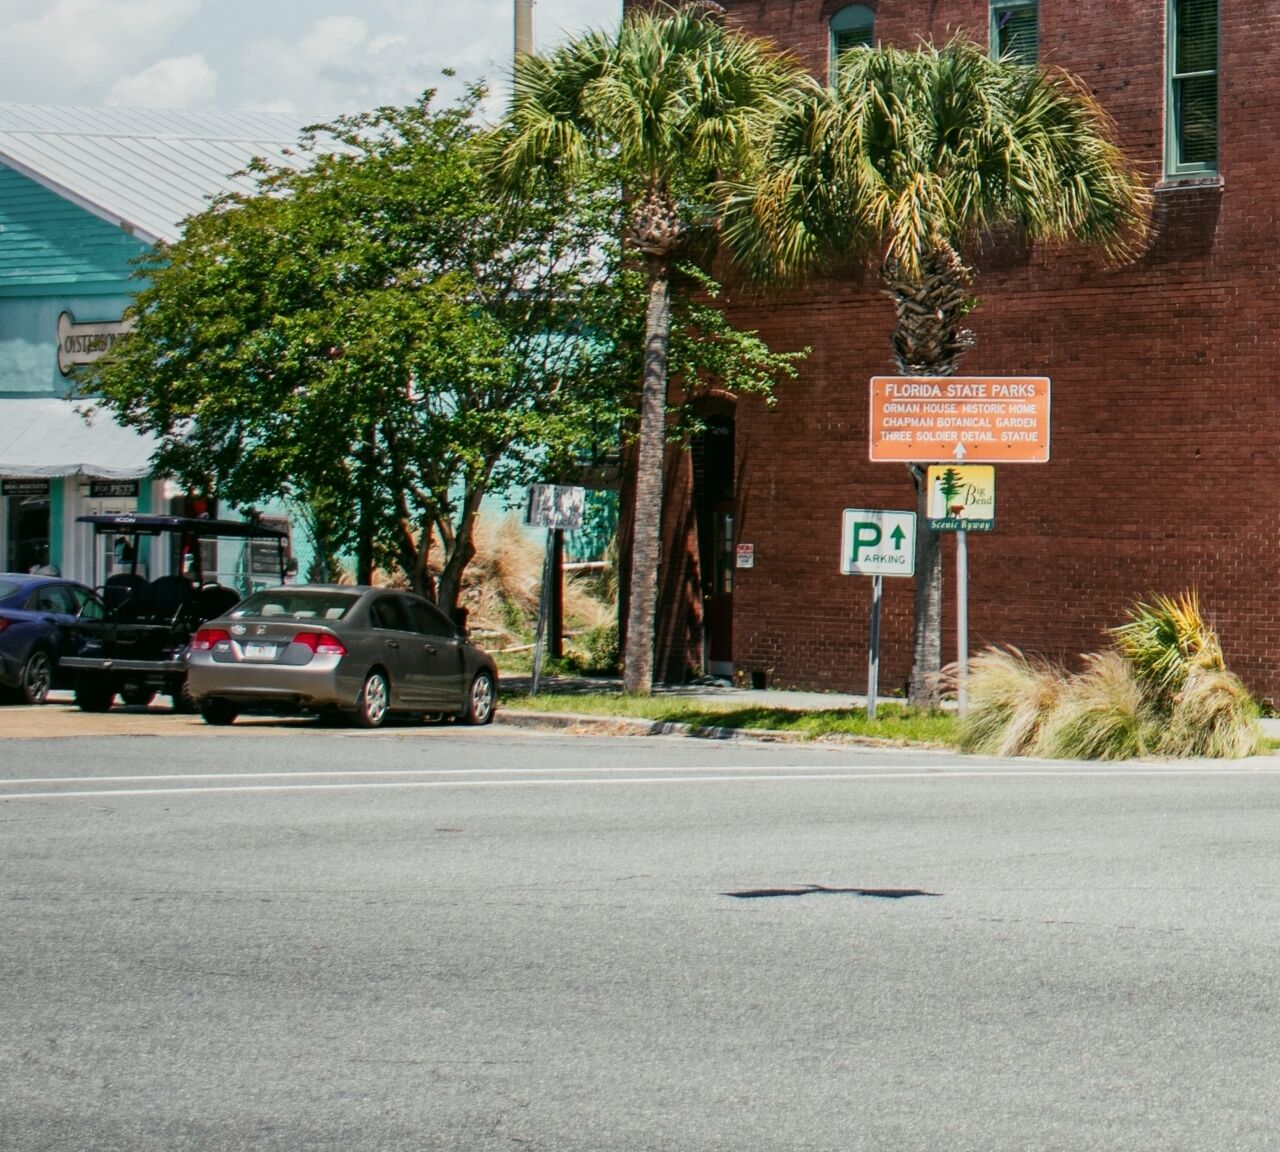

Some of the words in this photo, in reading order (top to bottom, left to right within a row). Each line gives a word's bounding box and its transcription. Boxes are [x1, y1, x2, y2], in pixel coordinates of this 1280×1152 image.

[884, 383, 942, 397] FLORIDA
[945, 384, 987, 397] STATE
[991, 384, 1036, 397] PARKS
[883, 403, 920, 414] ORMAN
[962, 404, 1006, 414] HISTORIC
[1008, 404, 1038, 414] HOME
[882, 417, 934, 427] CHAPMAN
[936, 417, 992, 427] BOTANICAL
[996, 417, 1037, 427] GARDEN
[880, 431, 913, 441] THREE
[916, 431, 959, 441] SOLDIER
[1001, 431, 1039, 441] STATUE
[111, 483, 135, 494] PETS
[930, 520, 958, 529] Scenic
[960, 520, 991, 531] Byway
